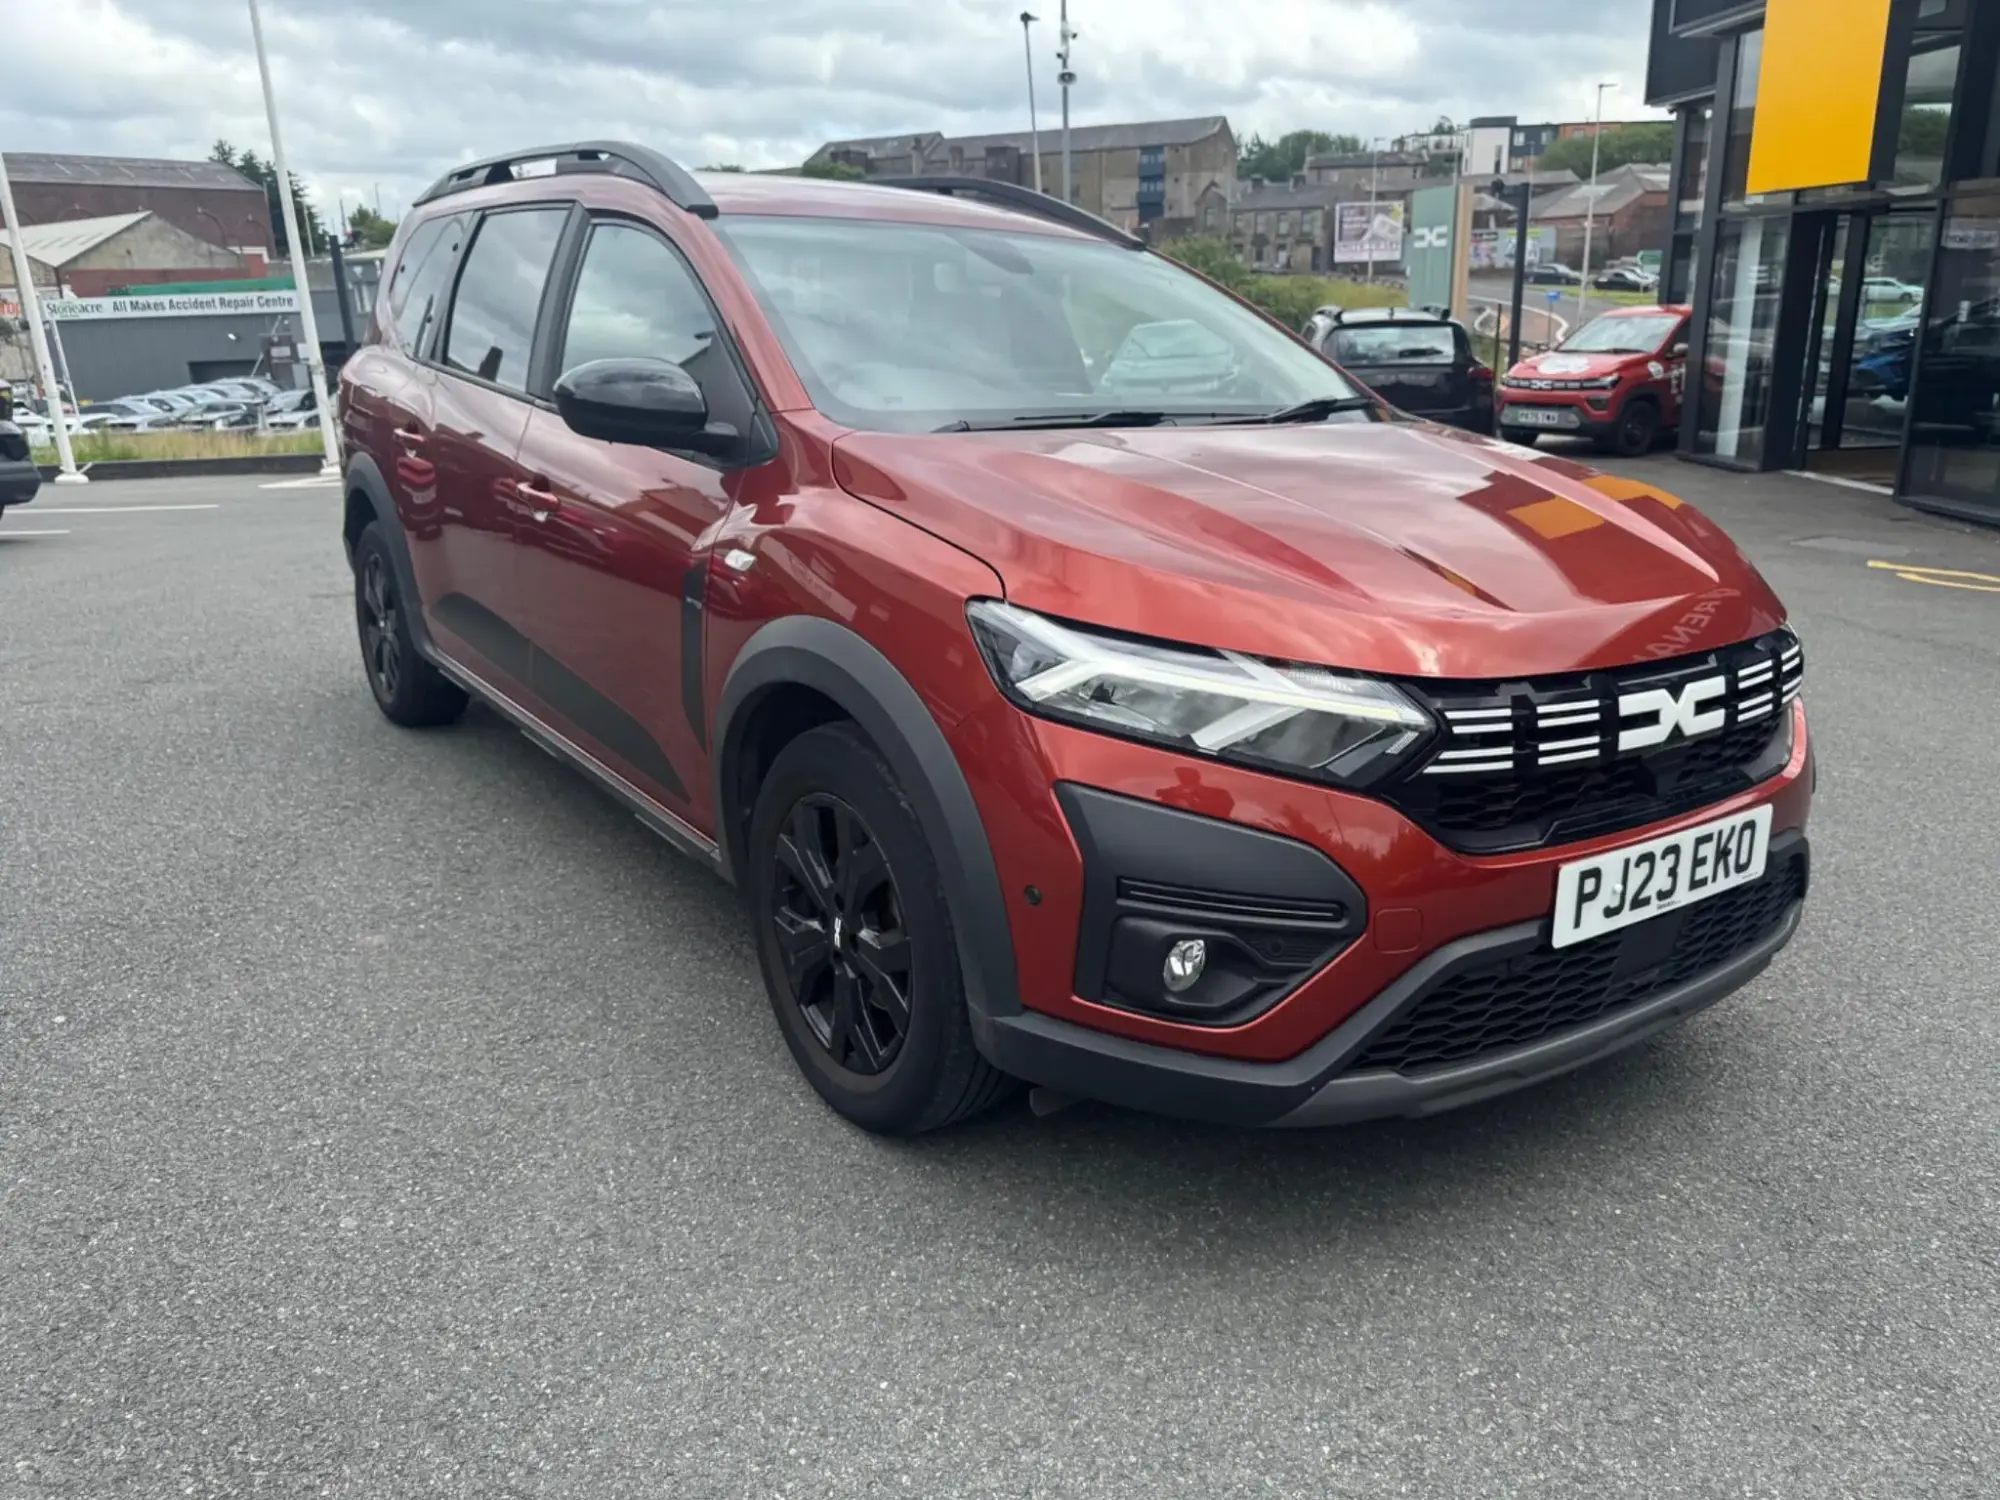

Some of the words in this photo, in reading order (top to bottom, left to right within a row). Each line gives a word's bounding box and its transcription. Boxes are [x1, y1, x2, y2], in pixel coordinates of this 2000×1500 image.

[46, 301, 103, 314] Stoneacre
[113, 300, 128, 312] All
[129, 299, 167, 312] Makes
[168, 297, 217, 310] Accident
[219, 296, 254, 309] Repair
[257, 295, 294, 308] Centre
[1573, 843, 1682, 930] PJ23
[1688, 819, 1757, 892] EKO
